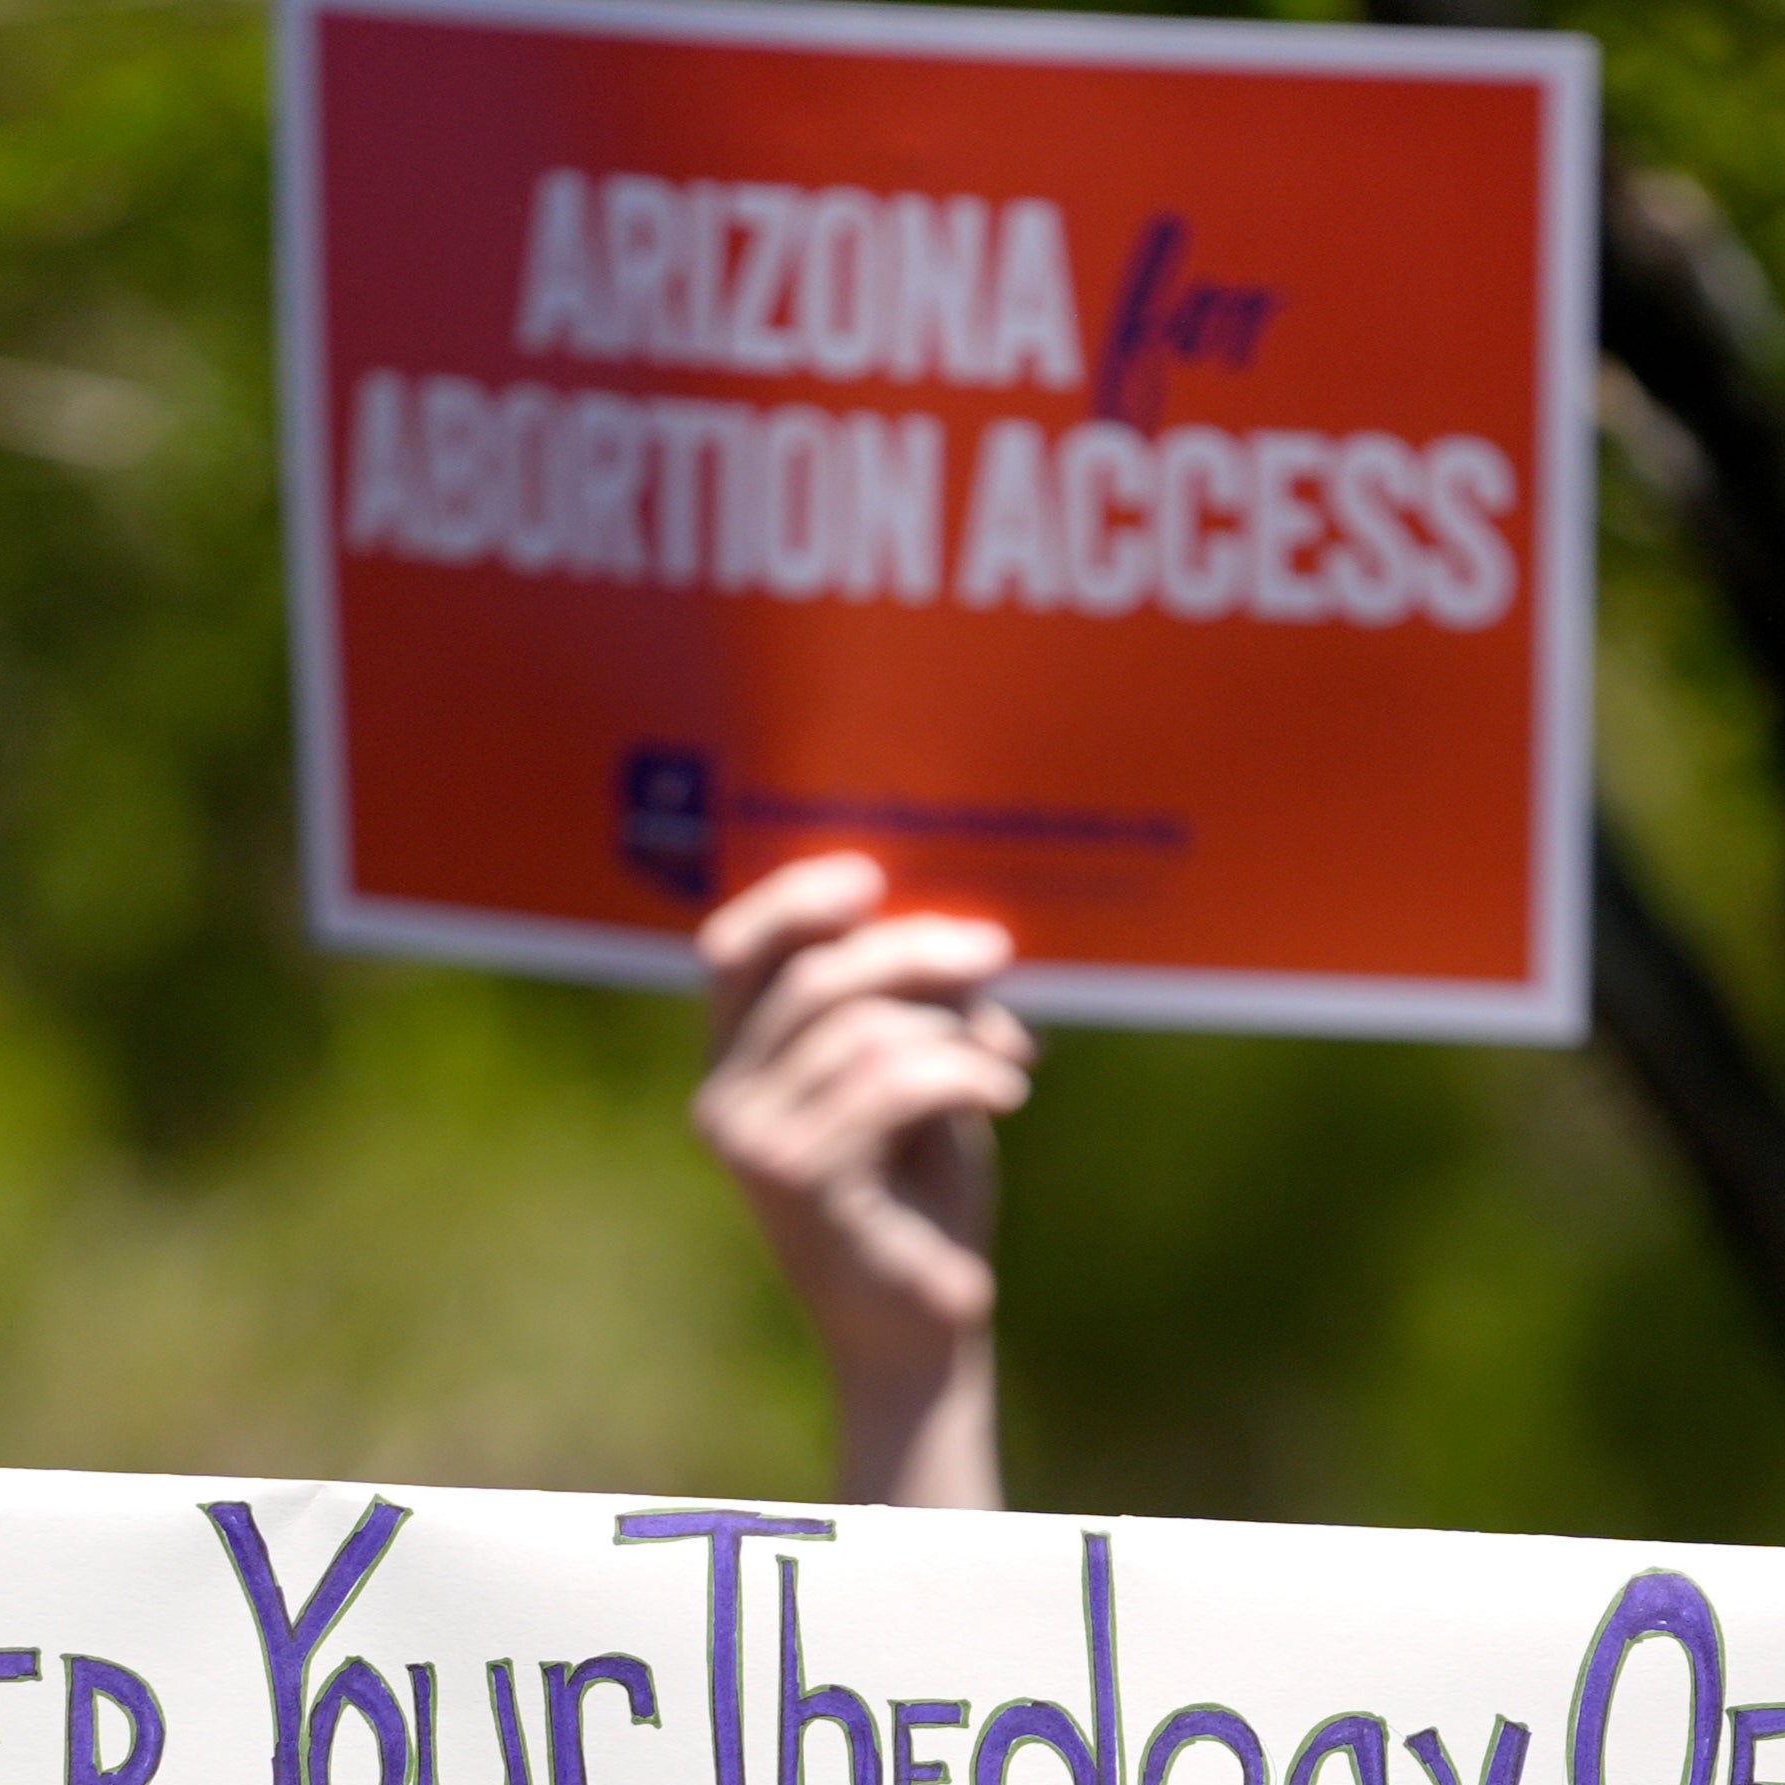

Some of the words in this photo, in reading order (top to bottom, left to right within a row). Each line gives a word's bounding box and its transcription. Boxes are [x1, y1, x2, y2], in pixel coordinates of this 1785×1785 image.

[518, 168, 1083, 394] ARIZONA
[1098, 213, 1281, 425] for
[348, 368, 945, 606] ABORTION
[956, 417, 1519, 631] ACCESS
